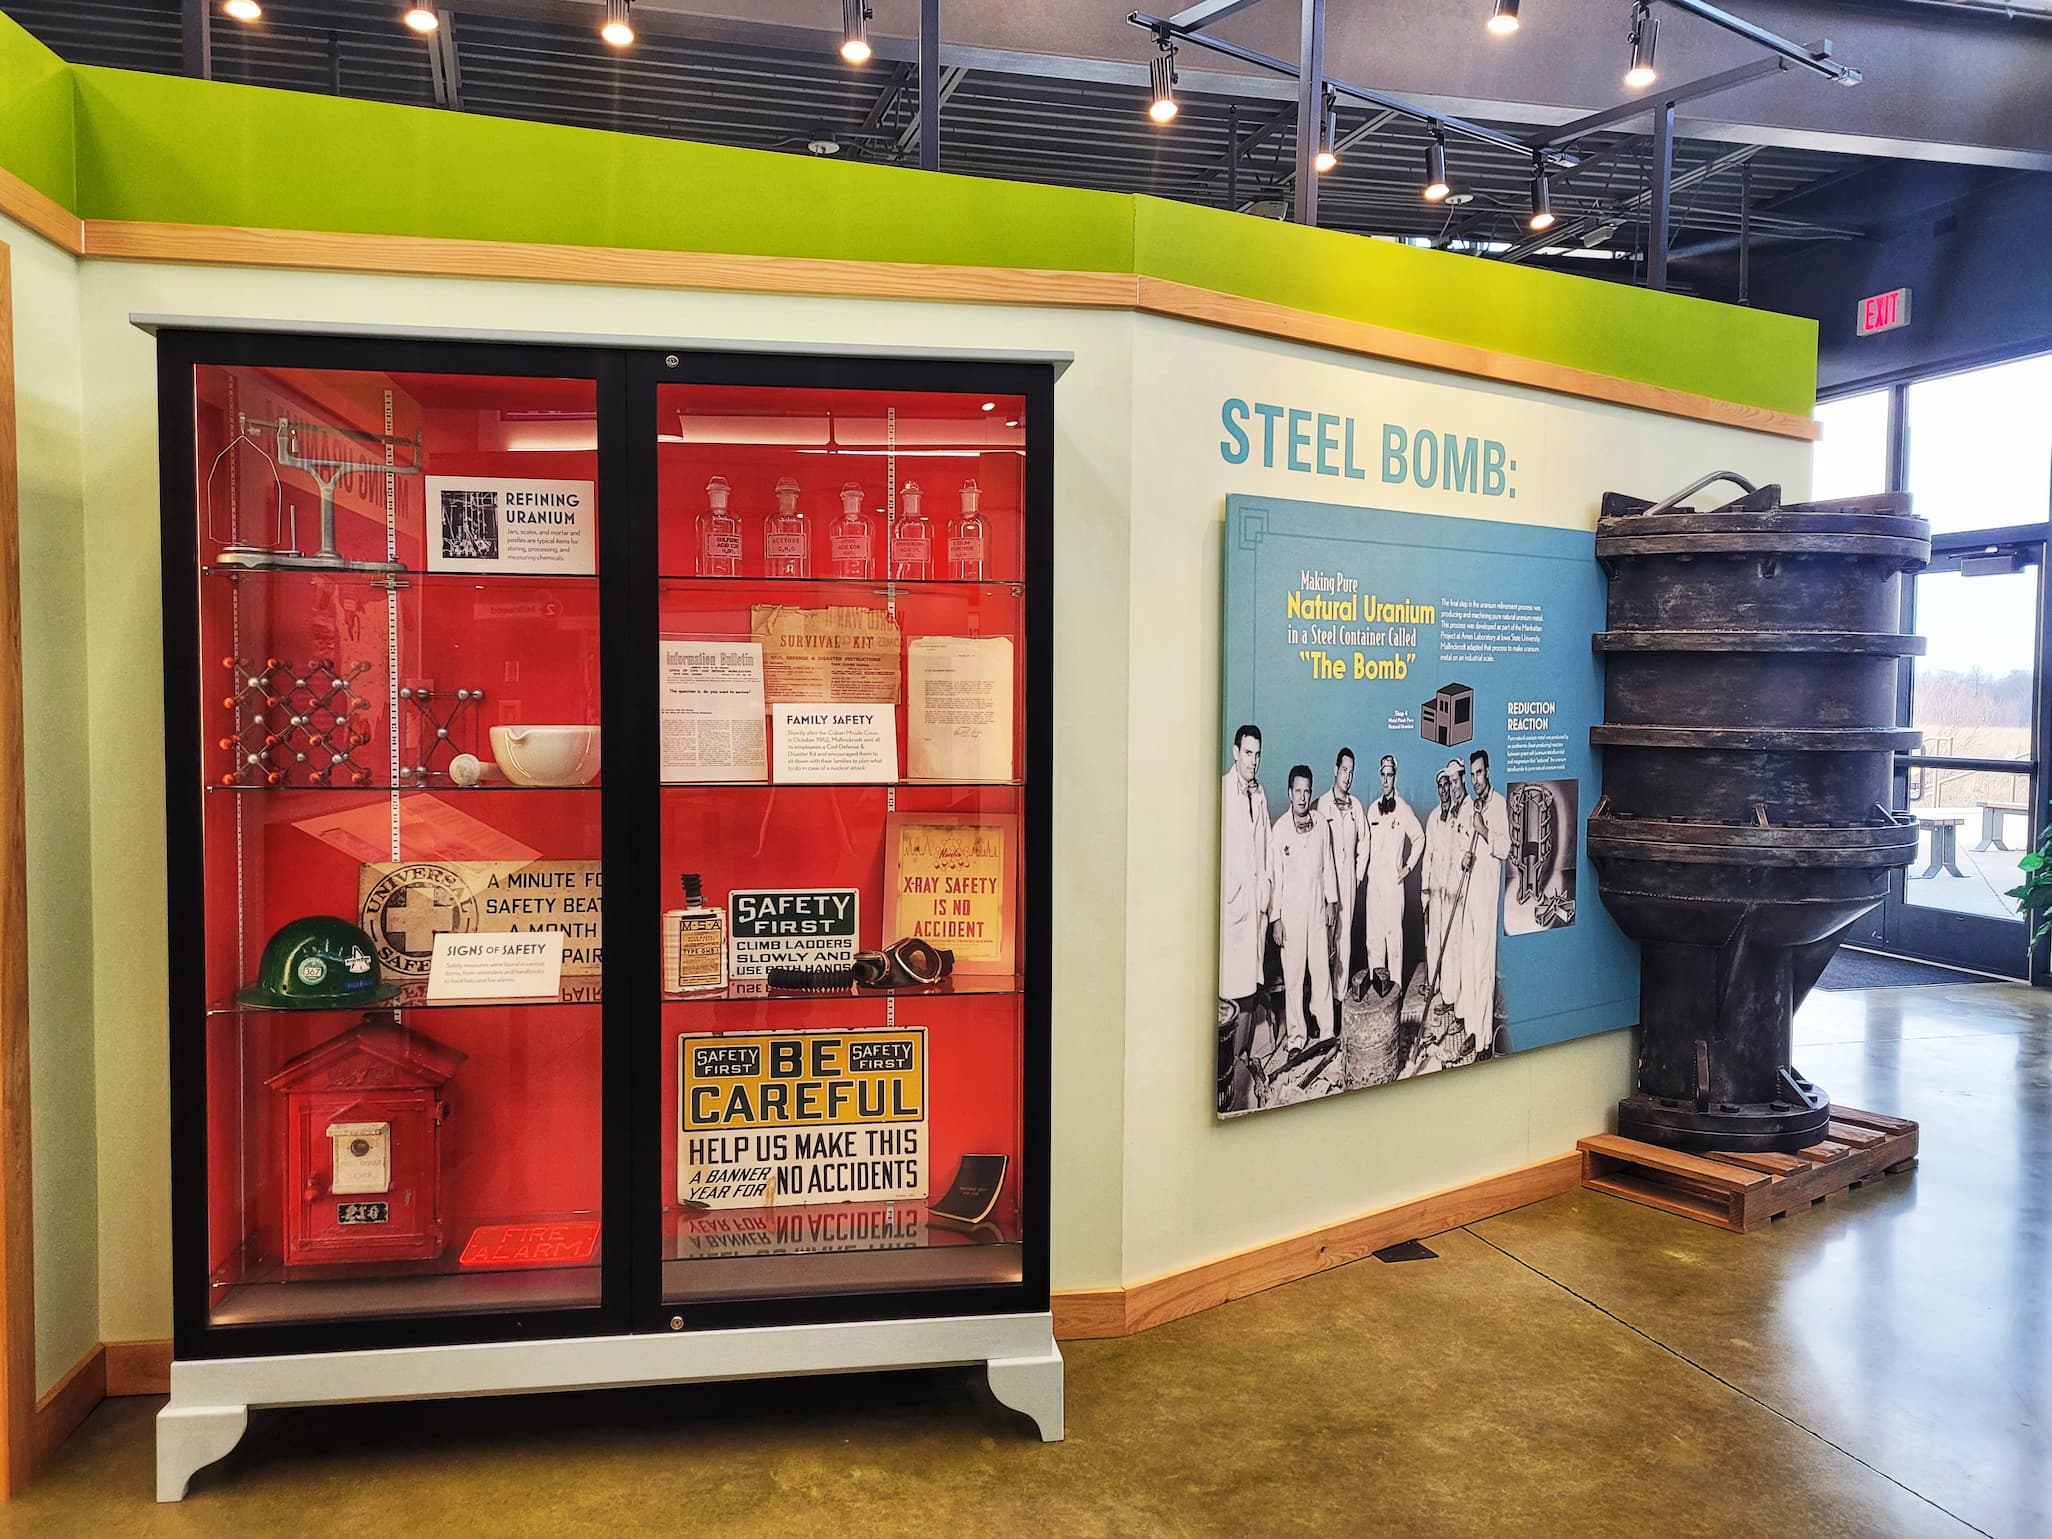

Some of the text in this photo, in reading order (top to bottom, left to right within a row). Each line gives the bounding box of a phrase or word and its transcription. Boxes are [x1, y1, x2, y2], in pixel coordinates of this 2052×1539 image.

[1865, 292, 1899, 330] EXIT
[1220, 398, 1516, 498] STEEL BOMB:
[506, 492, 580, 507] REFINING
[506, 510, 575, 524] URANIUM
[1301, 570, 1358, 596] Making Pure
[1287, 590, 1435, 624] Natural Uranium
[780, 635, 841, 648] SURVIVAL
[853, 636, 874, 648] KIT
[1288, 624, 1416, 647] in a Steel Container Called
[667, 651, 754, 666] Information Bulletin
[1394, 710, 1404, 718] Step
[1507, 702, 1555, 714] REDUCTION
[787, 715, 873, 725] FAMILY SAFETY
[1507, 717, 1548, 731] REACTION
[487, 873, 499, 888] A
[508, 873, 575, 888] MINUTE
[903, 876, 997, 894] X-RAY SAFETY
[366, 867, 473, 914] UNIVERSAL
[486, 898, 556, 914] SAFETY
[738, 895, 850, 923] SAFETY
[934, 899, 970, 916] IS NO
[754, 920, 835, 934] FIRST
[914, 920, 984, 938] ACCIDENT
[447, 944, 546, 956] SIGNS OF SAFETY
[737, 939, 852, 950] CLIMB LADDERS
[377, 946, 432, 972] SAFE
[737, 952, 850, 963] SLOWLY AND
[737, 966, 762, 975] USE
[697, 1049, 758, 1066] SAFETY
[770, 1040, 841, 1078] BE
[852, 1044, 911, 1060] SAFETY
[704, 1064, 752, 1075] FIRST
[859, 1059, 905, 1069] FIRST
[691, 1079, 919, 1124] CAREFUL
[689, 1129, 918, 1165] HELP US MAKE THIS
[689, 1160, 918, 1195] A BANNER NO ACCIDENTS
[689, 1183, 766, 1200] YEAR FOR
[501, 1227, 568, 1243] FIRE
[472, 1241, 583, 1260] ALARM
